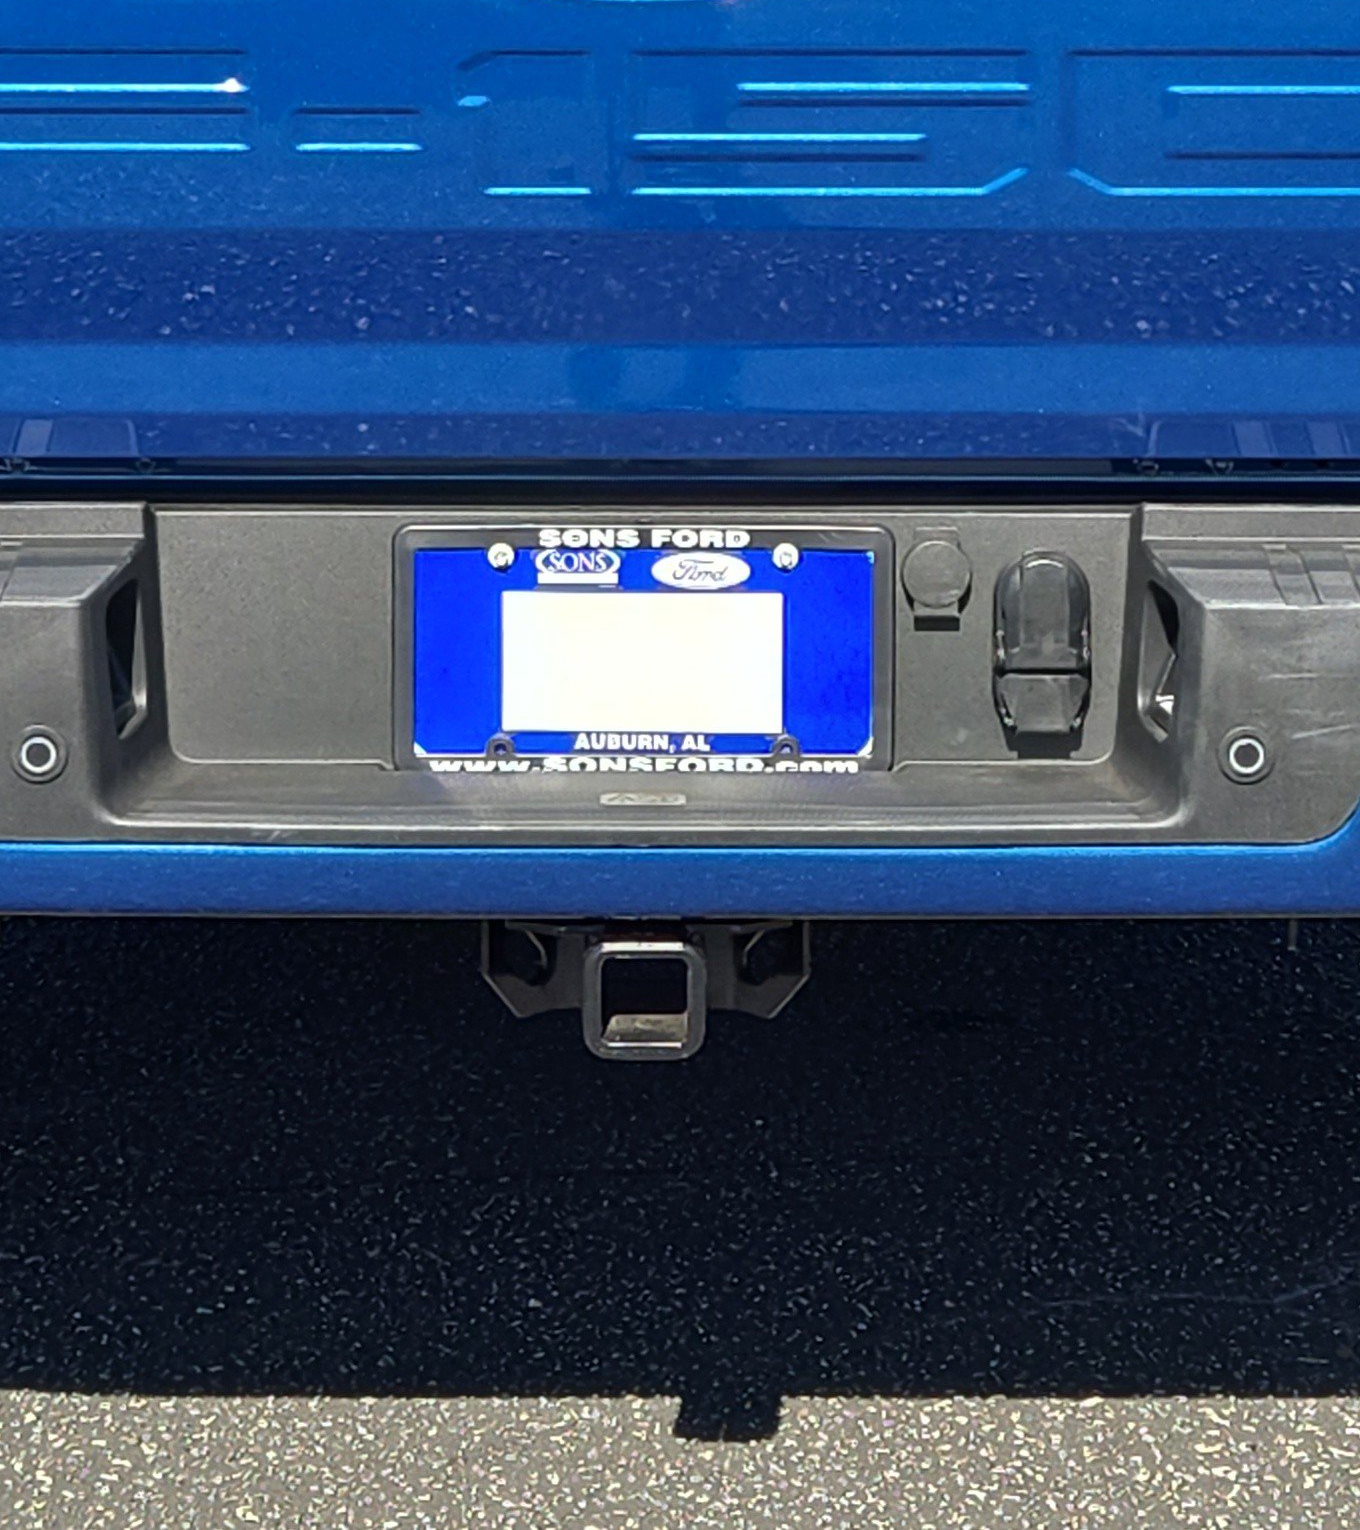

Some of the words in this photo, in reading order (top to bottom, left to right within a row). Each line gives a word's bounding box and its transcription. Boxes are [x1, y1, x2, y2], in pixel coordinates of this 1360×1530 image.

[538, 529, 640, 548] SONS
[651, 529, 751, 548] FORD
[549, 550, 608, 573] SONS
[672, 558, 729, 582] Ford
[574, 733, 677, 754] AUBURN,
[681, 733, 711, 752] AL
